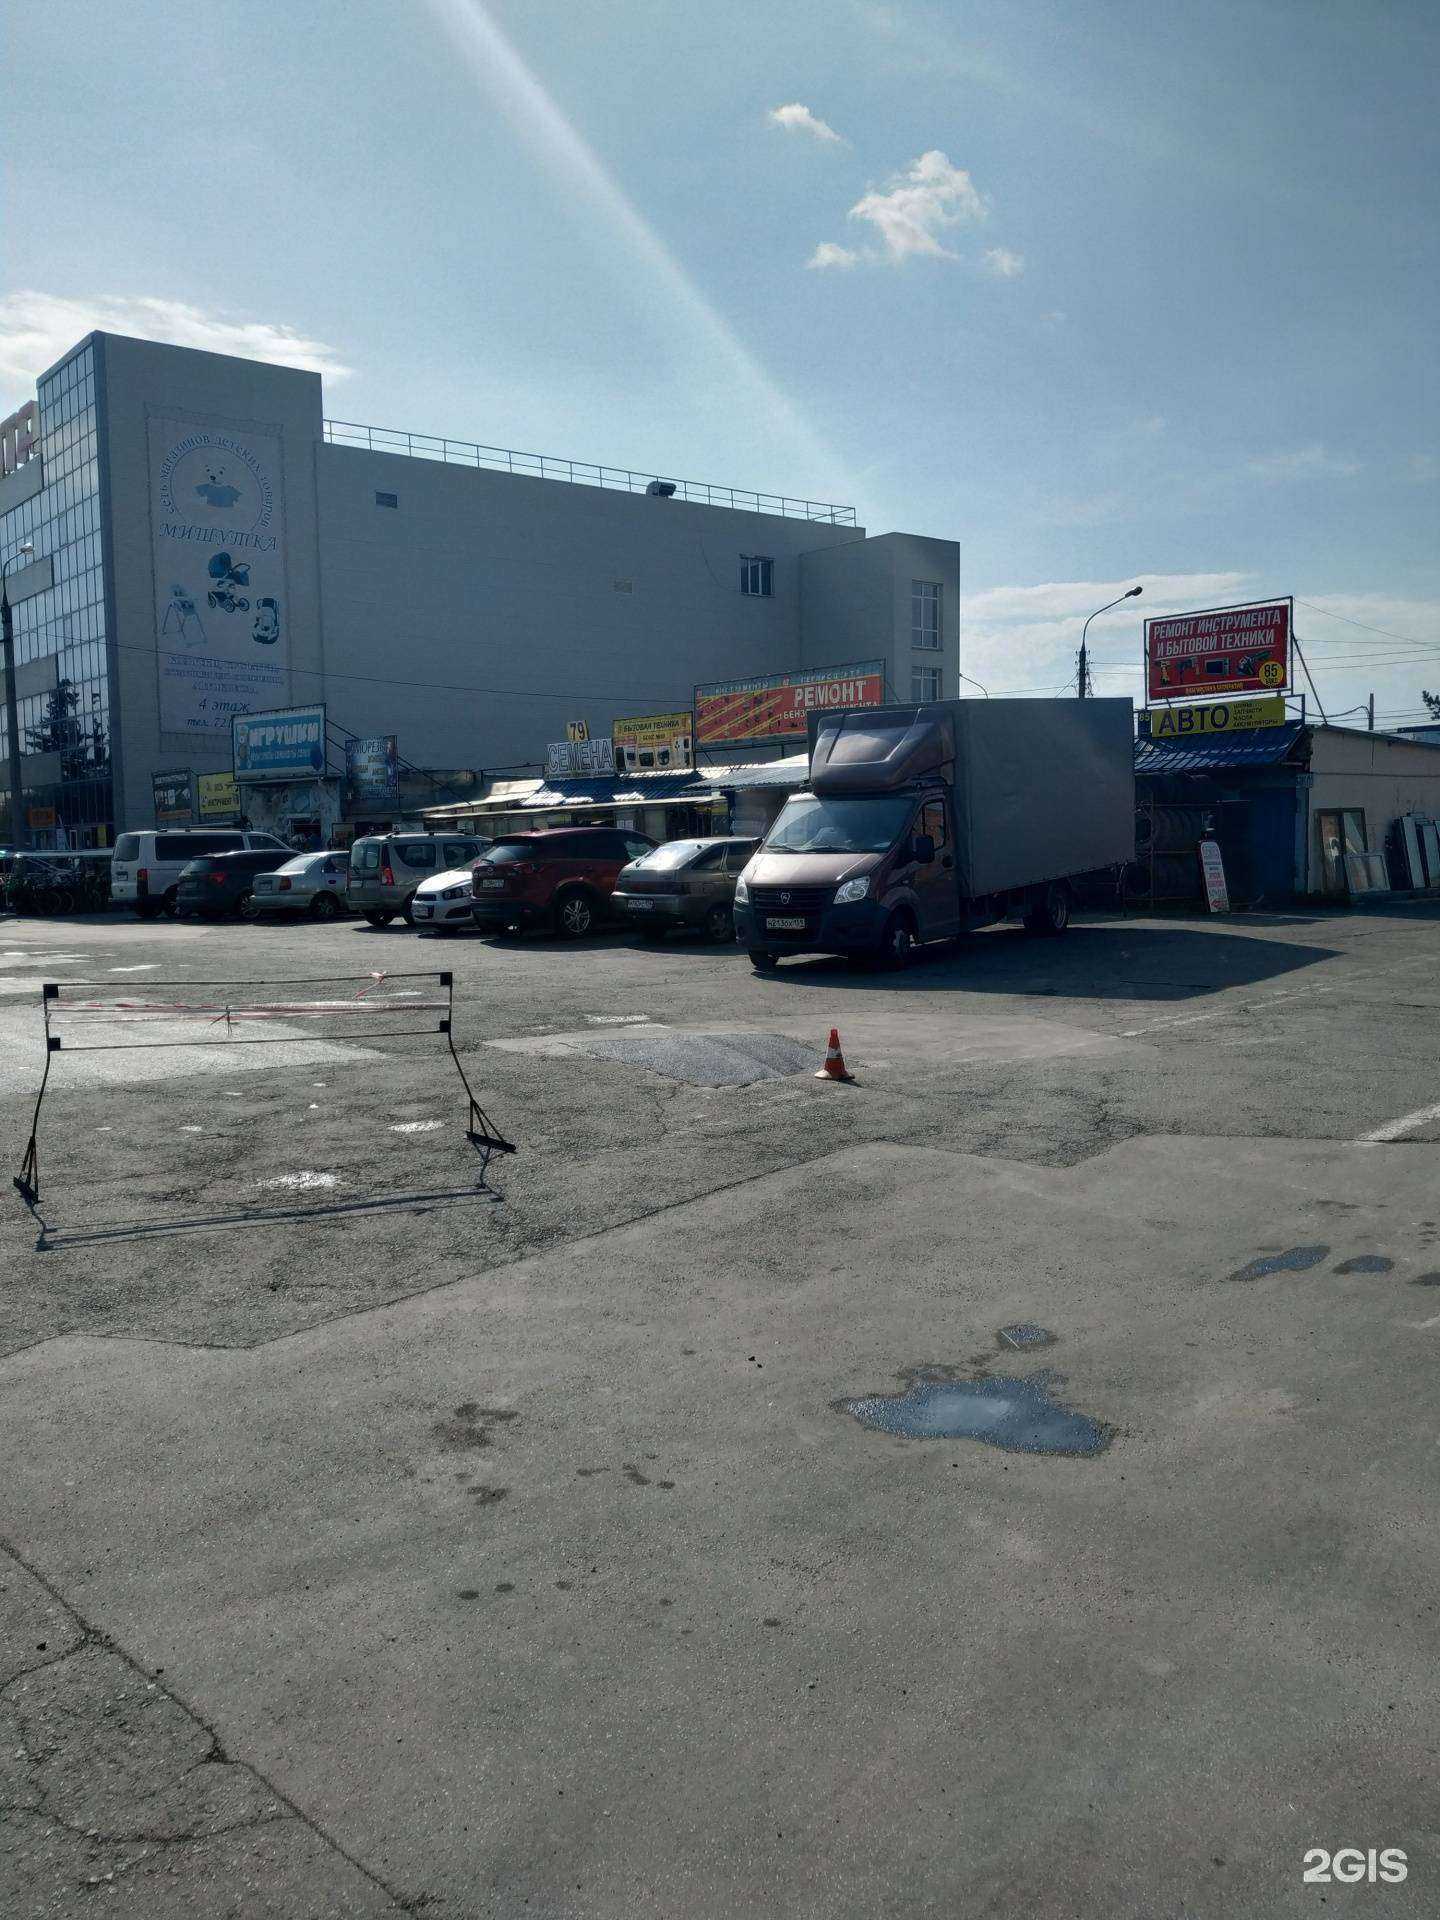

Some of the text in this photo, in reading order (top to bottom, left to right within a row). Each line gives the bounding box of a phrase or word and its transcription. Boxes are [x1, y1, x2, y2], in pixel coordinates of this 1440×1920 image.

[160, 521, 278, 552] МИШУТКА
[1153, 609, 1281, 640] РЕМОНТ ИНСТРУМЕНТА
[1157, 628, 1275, 657] И БЫТОВОЙ ТЕХНИКИ
[198, 697, 250, 713] 4 этаж
[793, 680, 867, 708] РЕМОНТ
[249, 722, 319, 747] ИГРУШКИ
[570, 722, 585, 741] 79
[1158, 705, 1230, 735] АВТО
[548, 740, 614, 774] СЕМЕНА
